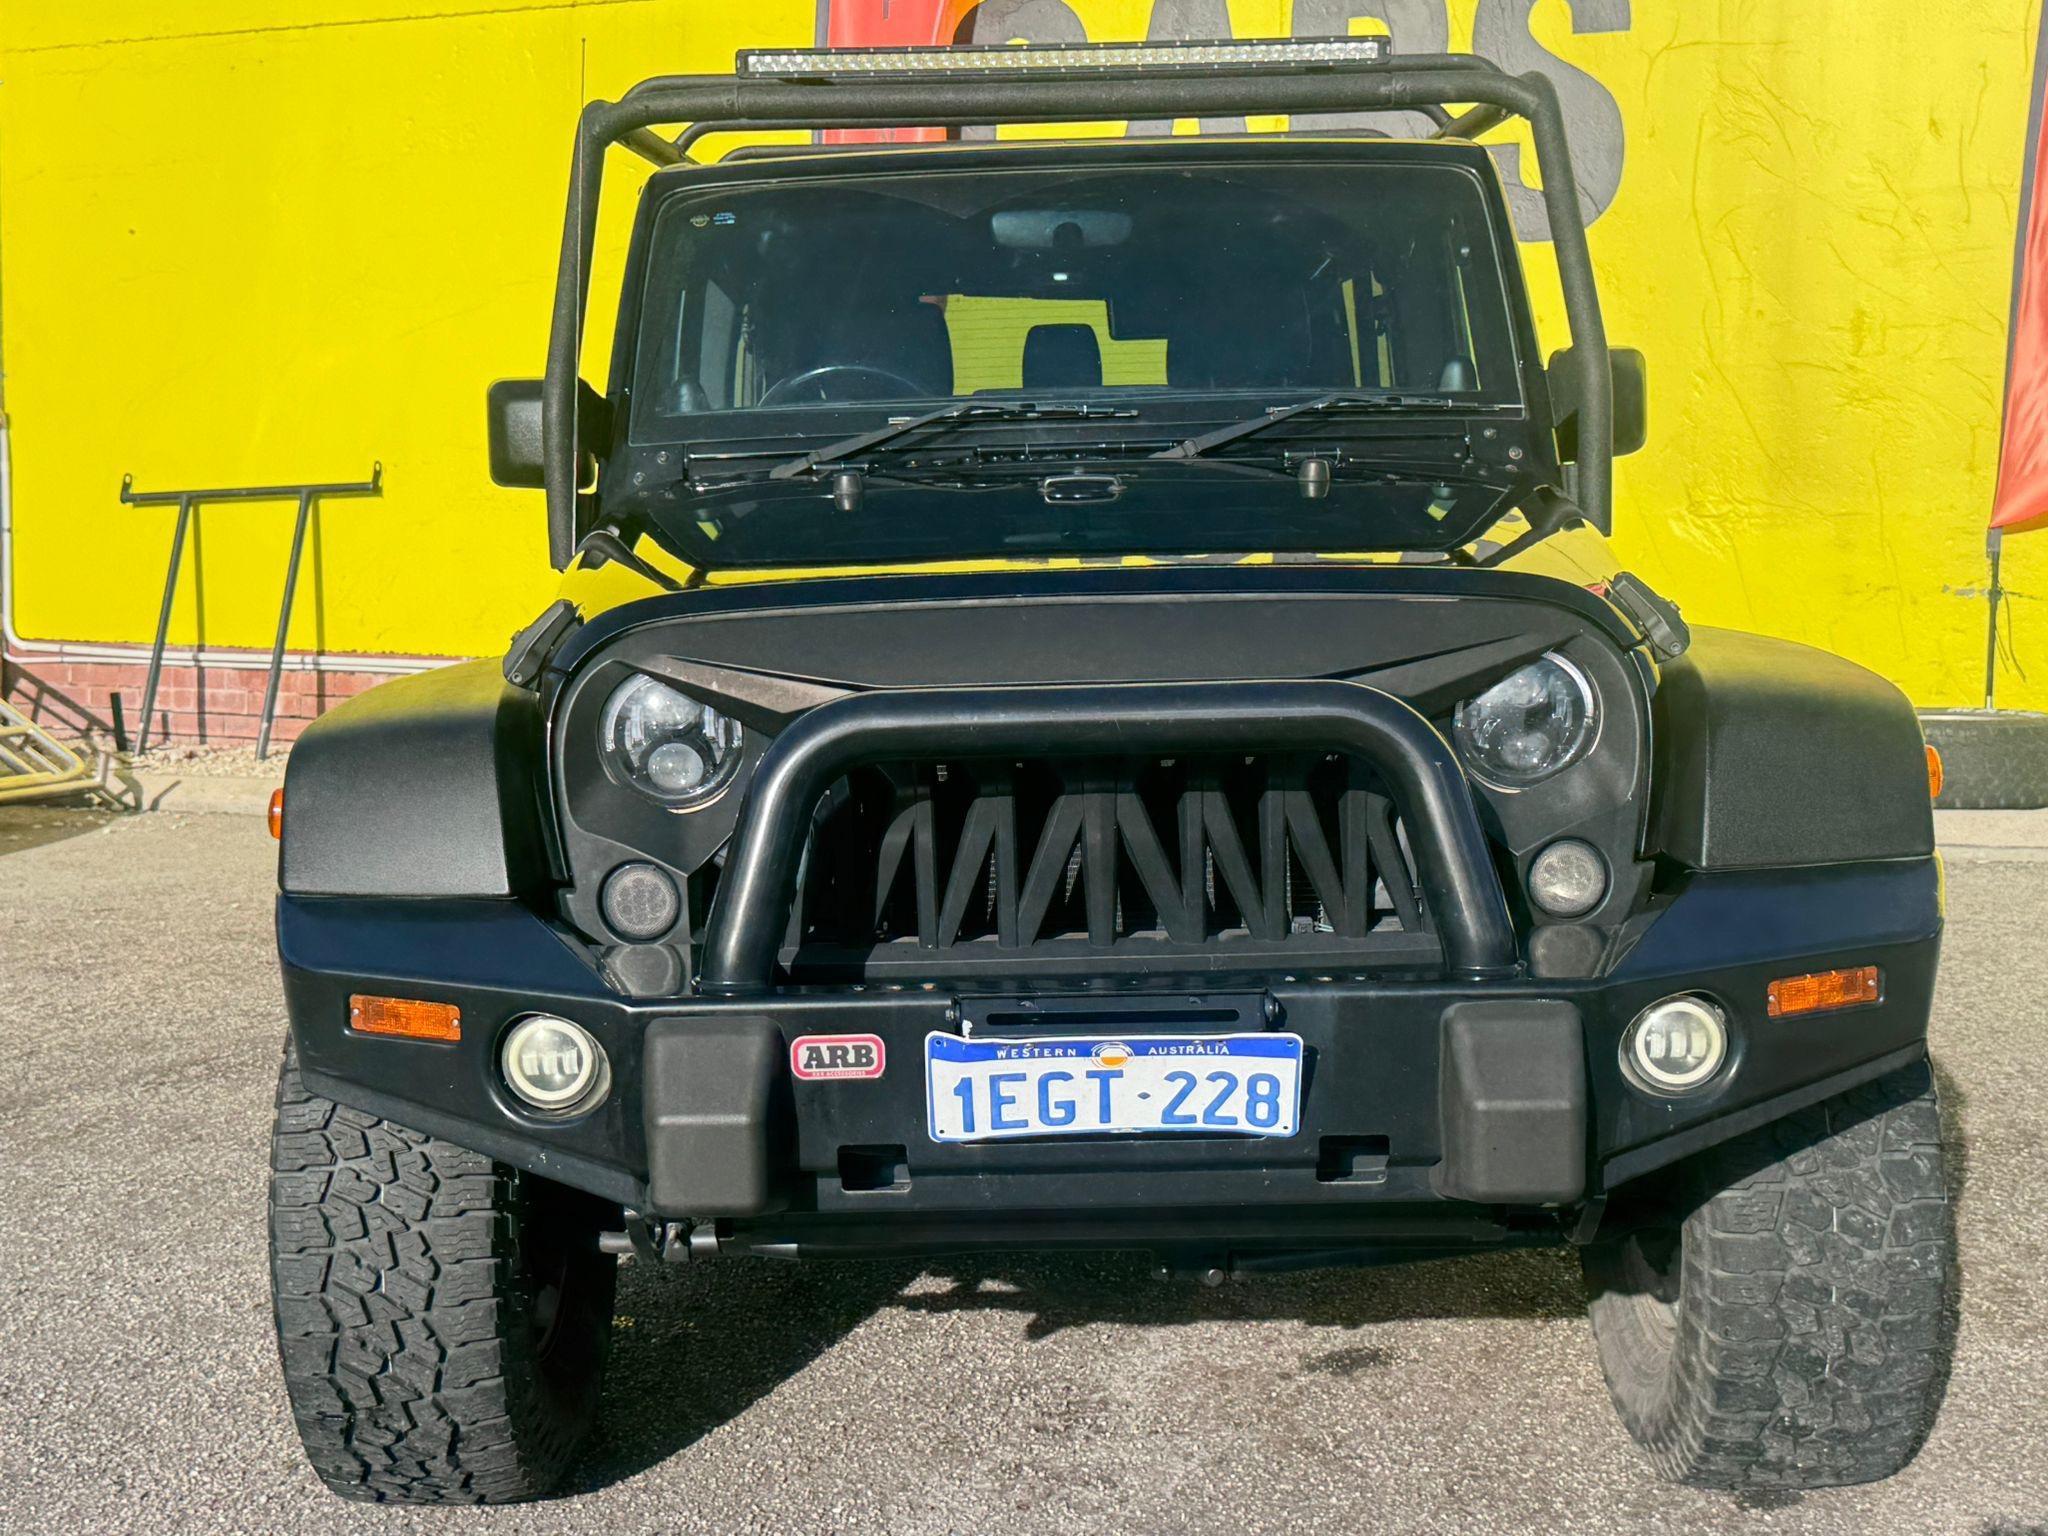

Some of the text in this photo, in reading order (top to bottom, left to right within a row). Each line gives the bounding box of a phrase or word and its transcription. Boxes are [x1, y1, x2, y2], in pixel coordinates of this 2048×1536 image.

[803, 1044, 874, 1069] ARB
[996, 1045, 1230, 1059] WESTERN AUSTRALIA
[953, 1069, 1281, 1133] 1EGT 228
